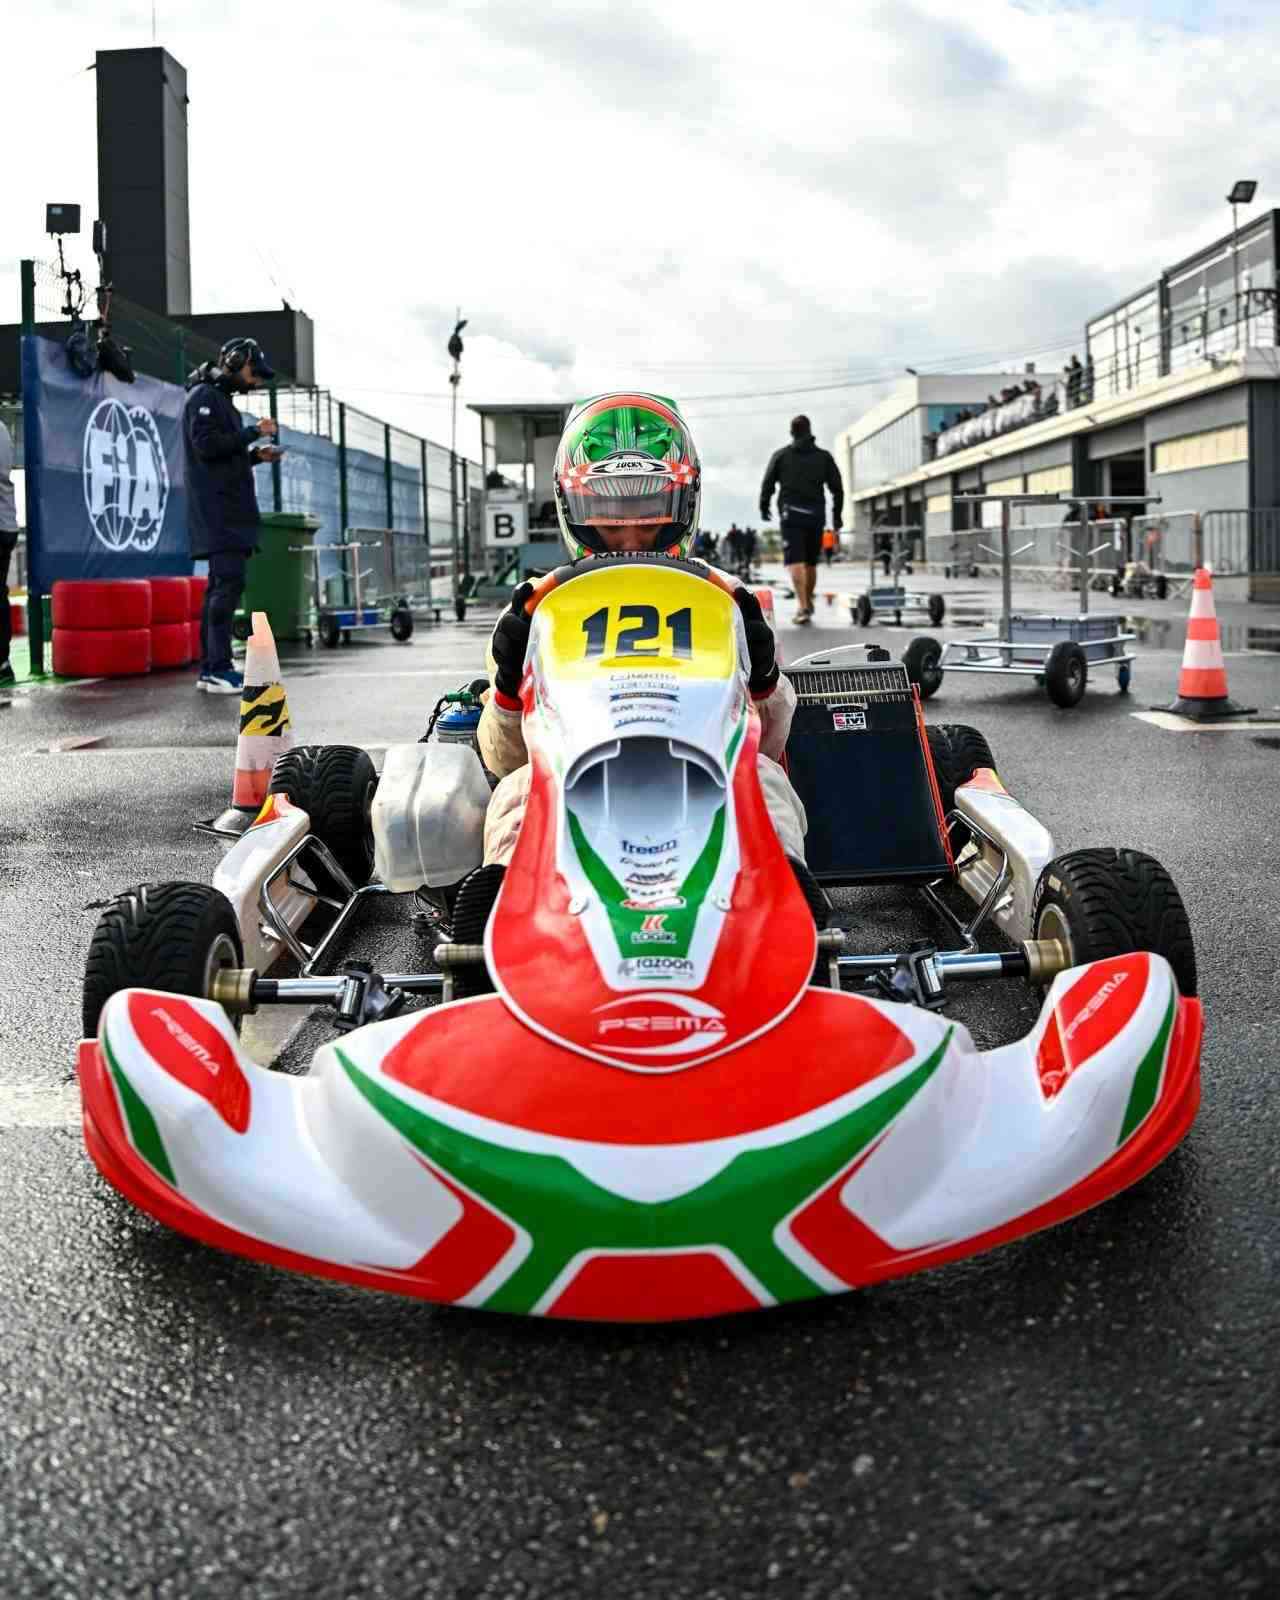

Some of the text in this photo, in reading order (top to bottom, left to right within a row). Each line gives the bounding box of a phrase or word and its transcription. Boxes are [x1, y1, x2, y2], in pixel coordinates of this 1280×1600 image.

[494, 513, 515, 539] B
[582, 604, 693, 660] 121
[636, 958, 695, 971] razoon
[598, 1015, 727, 1035] PREMA
[1065, 972, 1130, 1041] PREMA
[149, 1007, 220, 1076] PREMA
